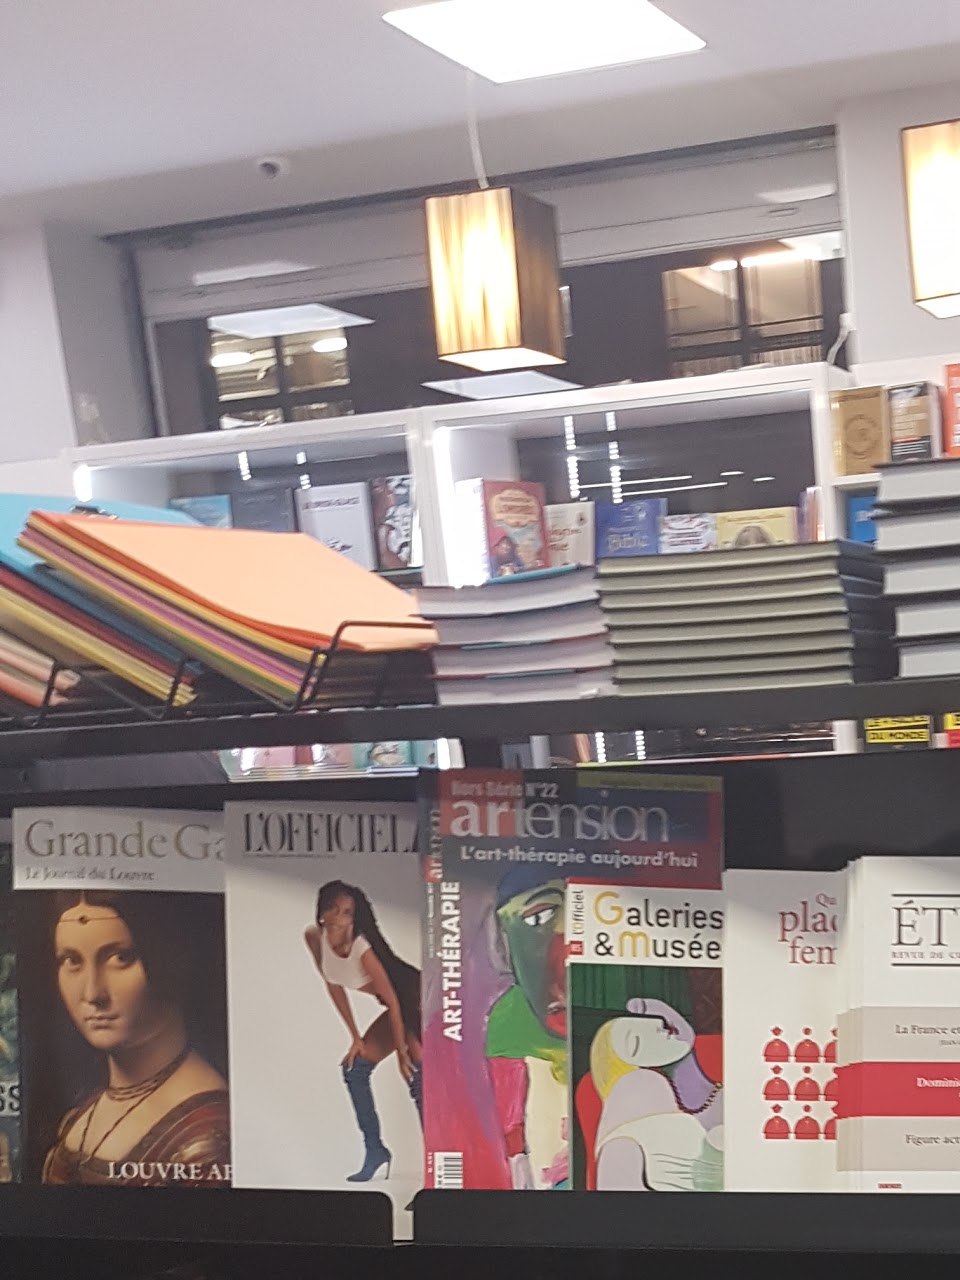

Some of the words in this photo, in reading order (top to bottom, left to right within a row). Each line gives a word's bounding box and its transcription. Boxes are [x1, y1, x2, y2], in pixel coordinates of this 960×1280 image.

[451, 791, 670, 843] artension
[25, 820, 167, 859] Grande
[461, 847, 586, 867] L'art-thérapie
[591, 852, 698, 868] aujourd'hui
[109, 868, 155, 880] Louvre
[594, 891, 723, 930] Galeries
[439, 881, 461, 1041] ART-THÉRAPIE
[896, 1025, 909, 1034] La
[912, 1025, 947, 1035] France
[906, 1135, 940, 1146] Figure
[108, 1162, 203, 1180] LOUVRE
